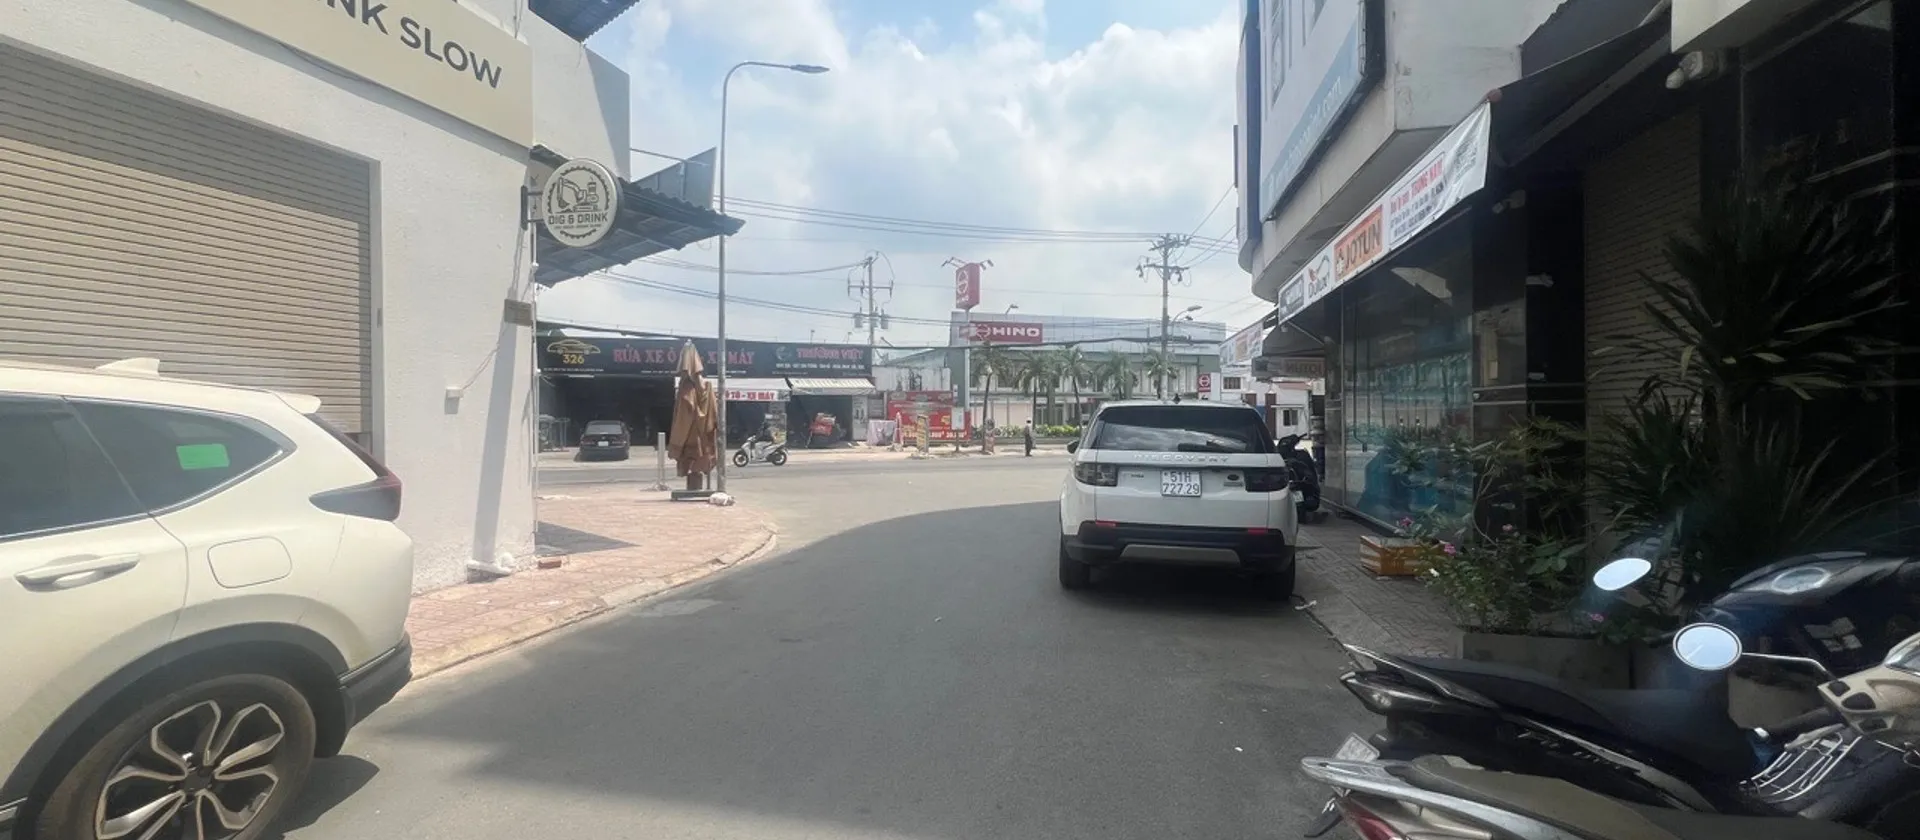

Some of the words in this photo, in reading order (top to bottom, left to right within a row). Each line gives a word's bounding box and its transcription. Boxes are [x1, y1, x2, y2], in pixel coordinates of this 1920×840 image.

[400, 16, 502, 89] SLOW
[548, 214, 565, 225] DIG
[577, 211, 608, 223] DRINK
[1344, 220, 1381, 268] JOTUN
[992, 327, 1040, 337] HINO
[562, 353, 585, 364] 326
[644, 348, 664, 364] XE
[727, 348, 755, 364] MÁY
[1134, 453, 1228, 463] DISCOVERY
[1170, 471, 1191, 482] 51H
[1162, 483, 1200, 495] 727.29
